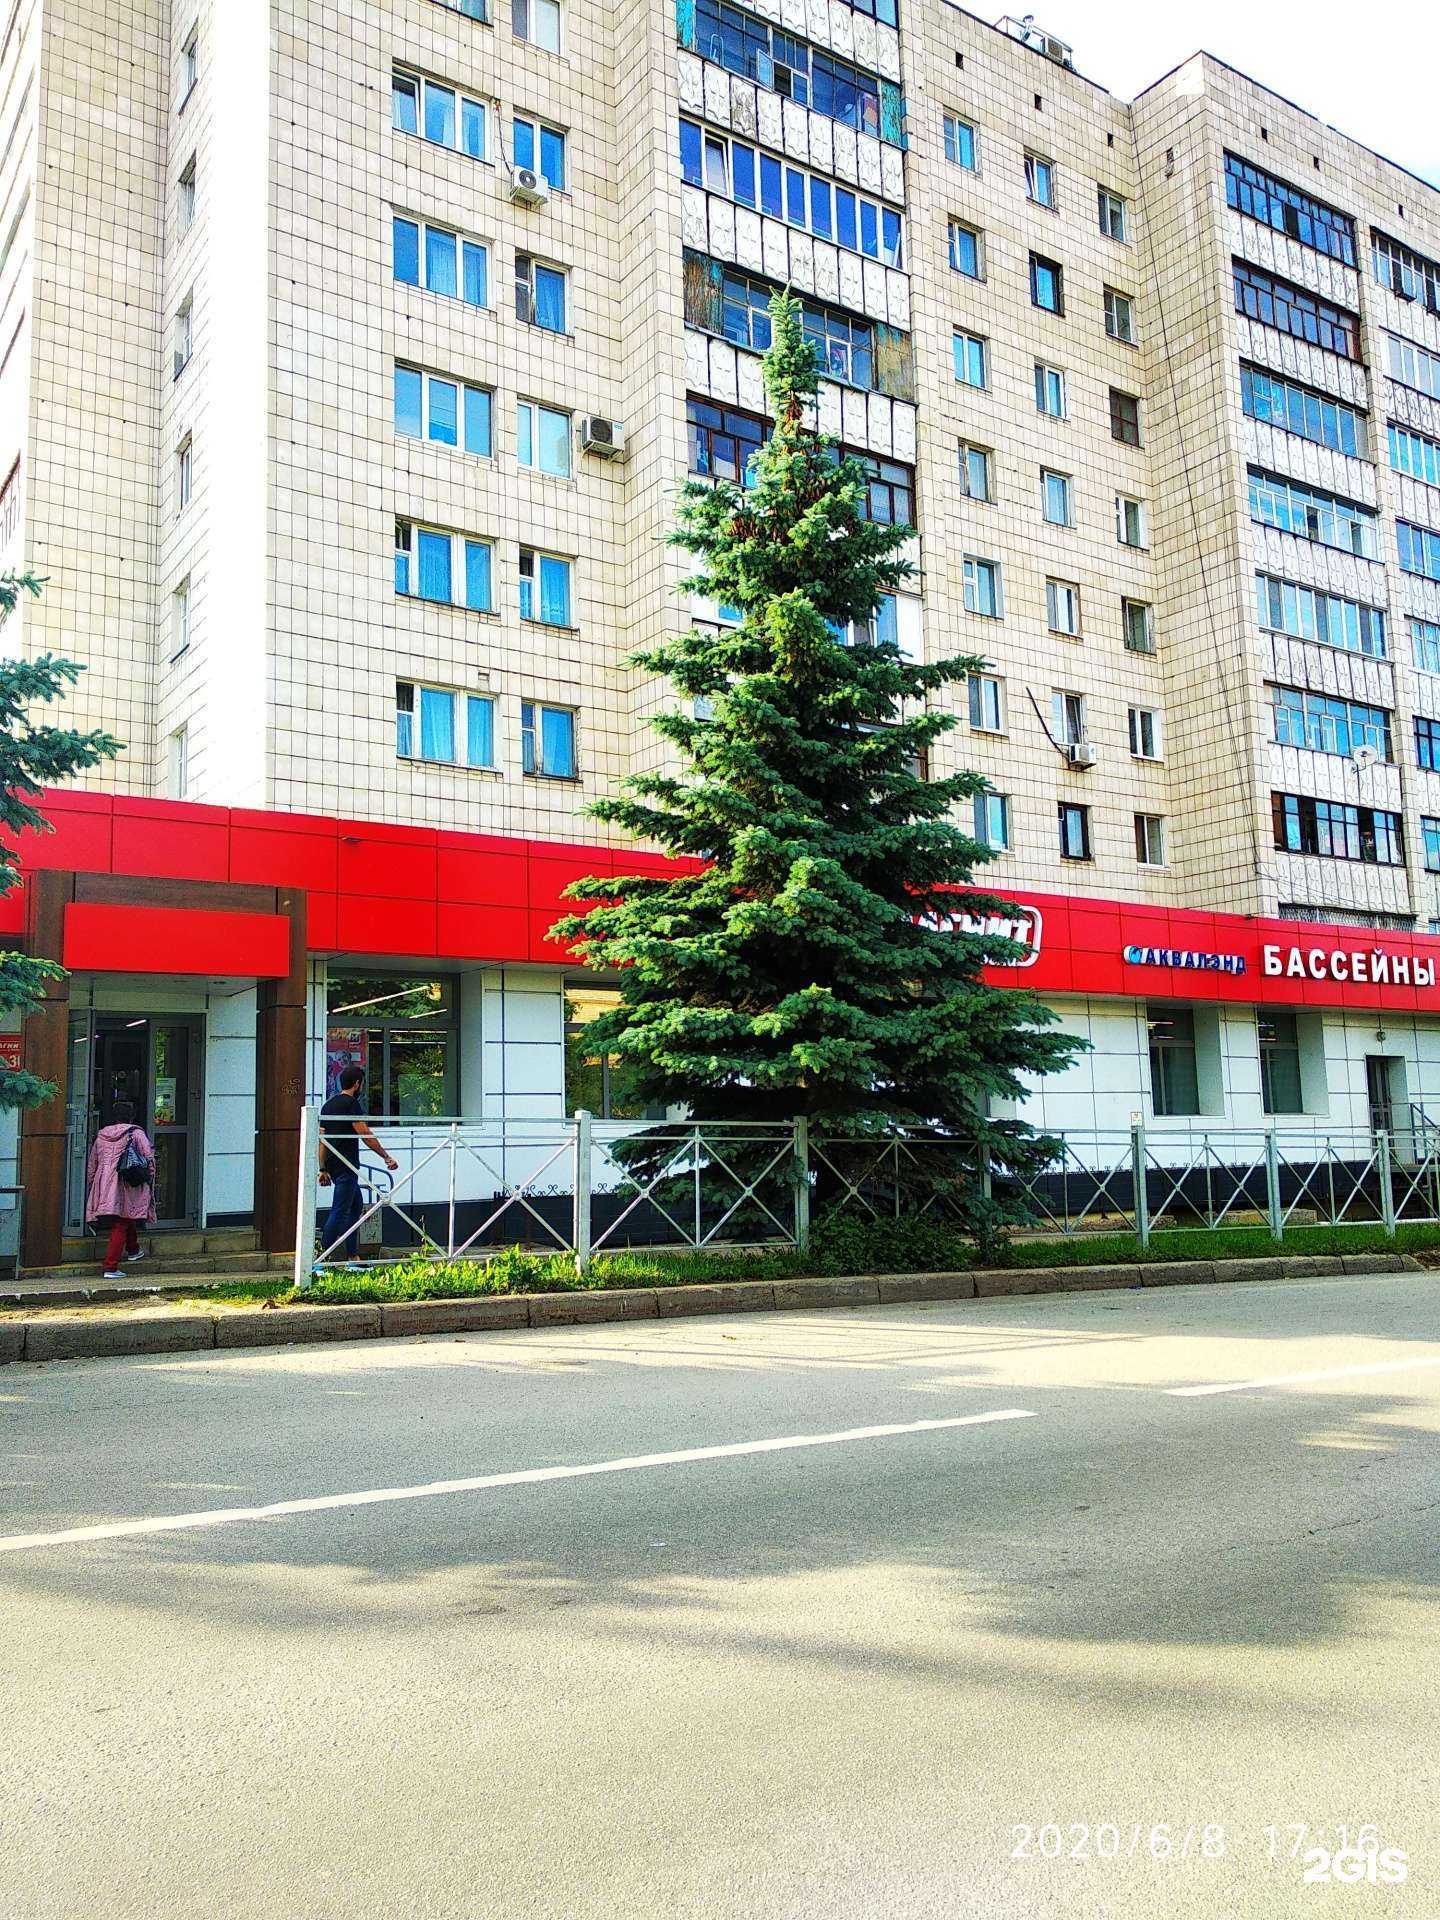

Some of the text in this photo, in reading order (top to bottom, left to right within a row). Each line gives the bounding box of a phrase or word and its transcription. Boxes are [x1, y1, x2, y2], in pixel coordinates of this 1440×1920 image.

[901, 909, 1033, 945] АГНИТ
[1145, 948, 1247, 975] АКВАЛЭНД
[1263, 944, 1436, 986] БАССЕЙНЫ
